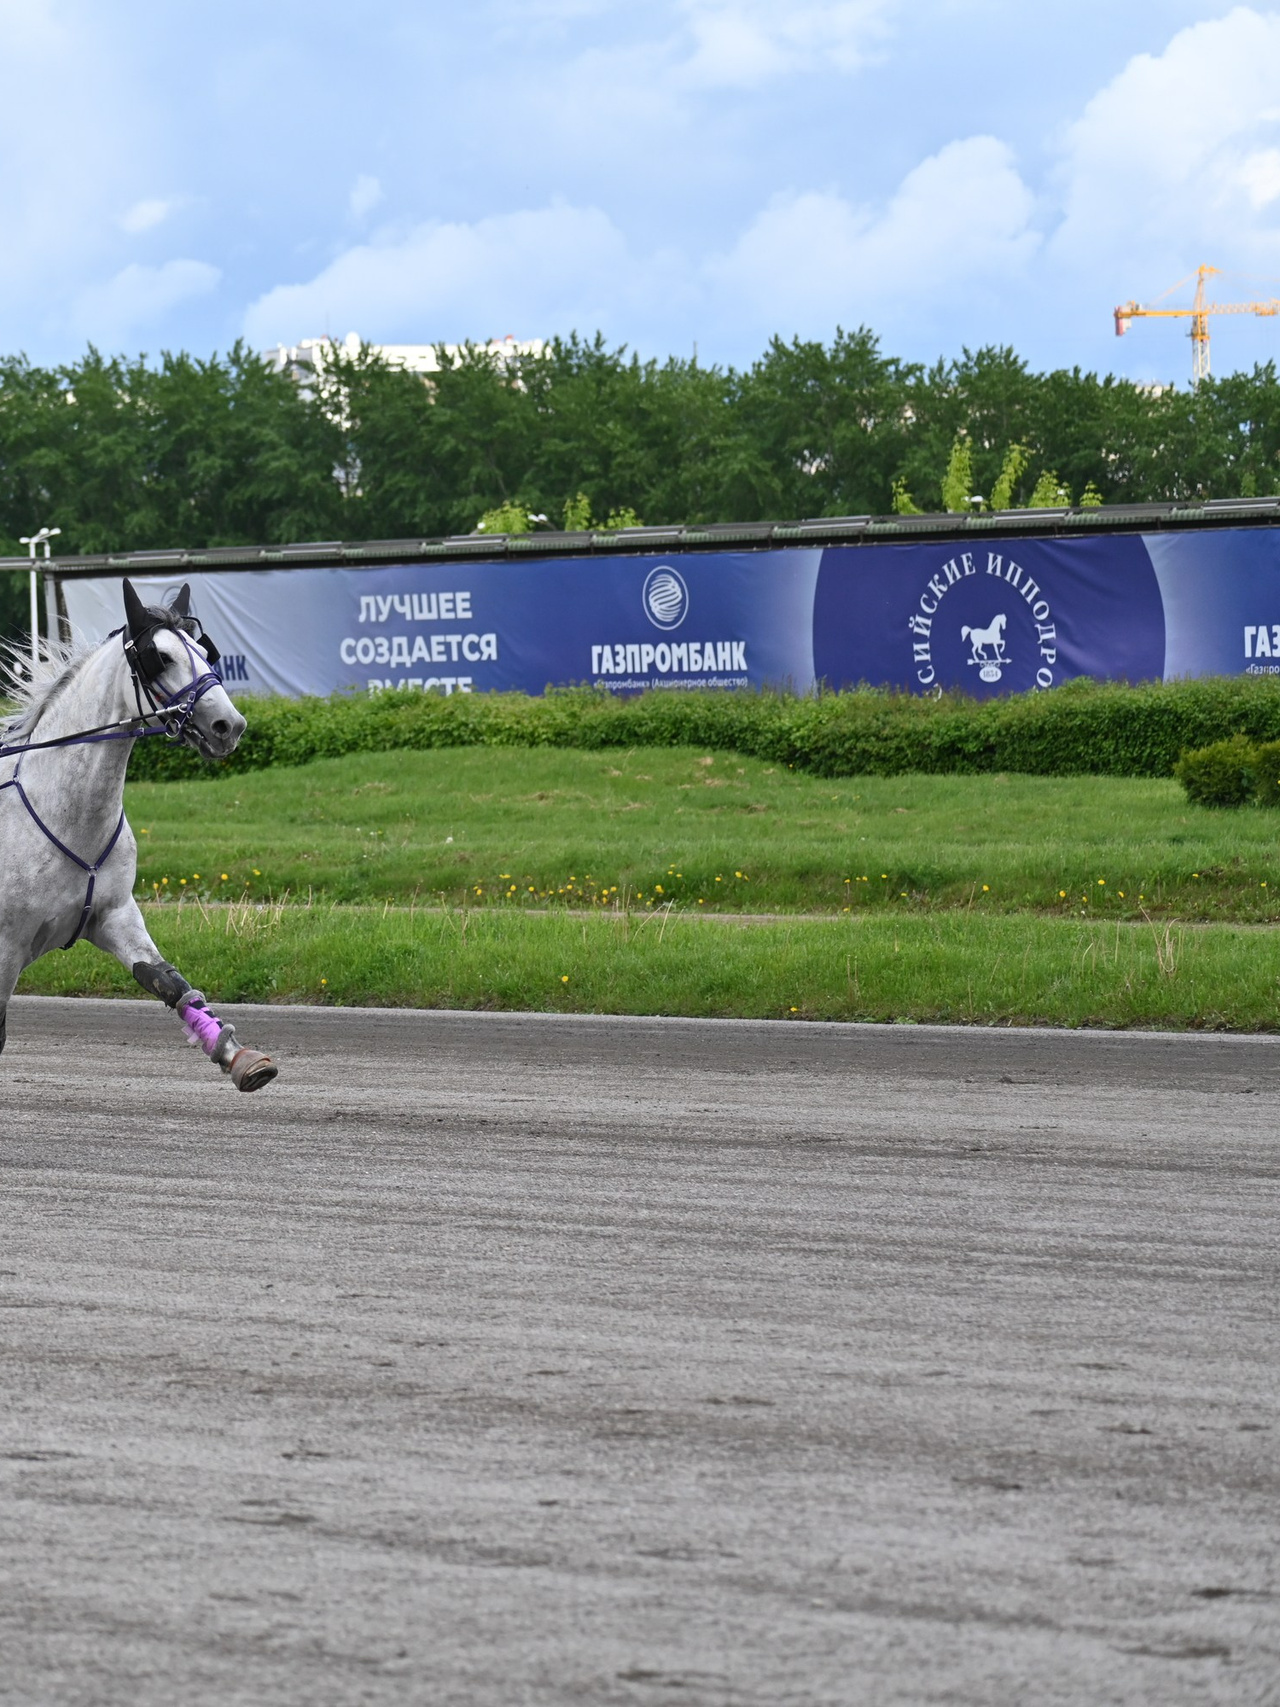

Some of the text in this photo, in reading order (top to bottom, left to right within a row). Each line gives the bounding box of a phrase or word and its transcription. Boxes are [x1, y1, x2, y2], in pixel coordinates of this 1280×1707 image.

[358, 591, 473, 623] ЛУЧШЕЕ
[986, 552, 1057, 691] ИППОДРО
[340, 633, 497, 668] СОЗДАЕТСЯ
[591, 641, 748, 675] ГАЗПРОМБАНК
